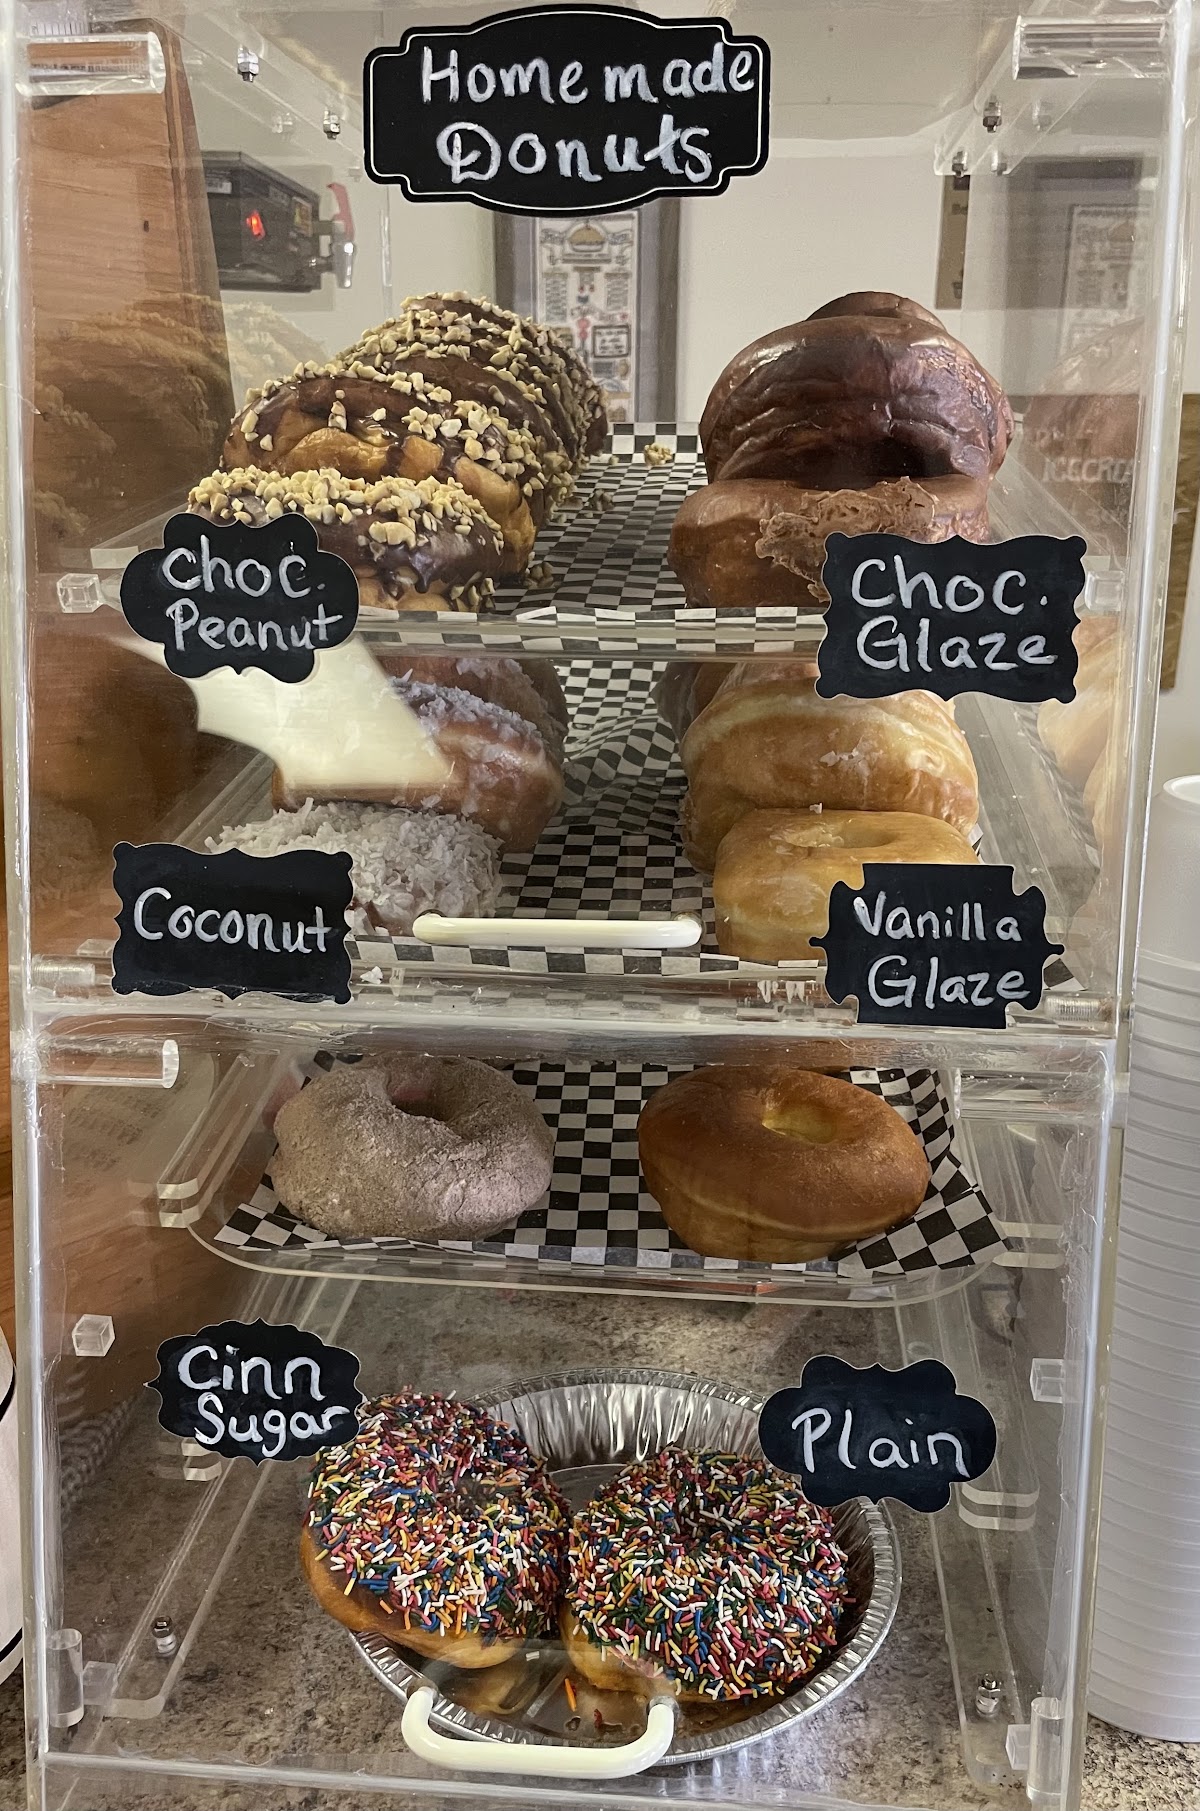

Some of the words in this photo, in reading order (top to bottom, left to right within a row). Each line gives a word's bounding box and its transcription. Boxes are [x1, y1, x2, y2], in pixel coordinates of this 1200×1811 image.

[436, 114, 712, 183] Donuts
[852, 554, 1047, 615] Choc.
[166, 597, 343, 651] Peanut
[857, 615, 1058, 672] Glaze
[134, 887, 332, 953] Coconut
[853, 891, 1022, 942] Vanilla
[868, 955, 1030, 1009] Glaze
[178, 1345, 325, 1400] Cinn
[194, 1392, 350, 1457] Sugar
[792, 1408, 970, 1478] Plain
